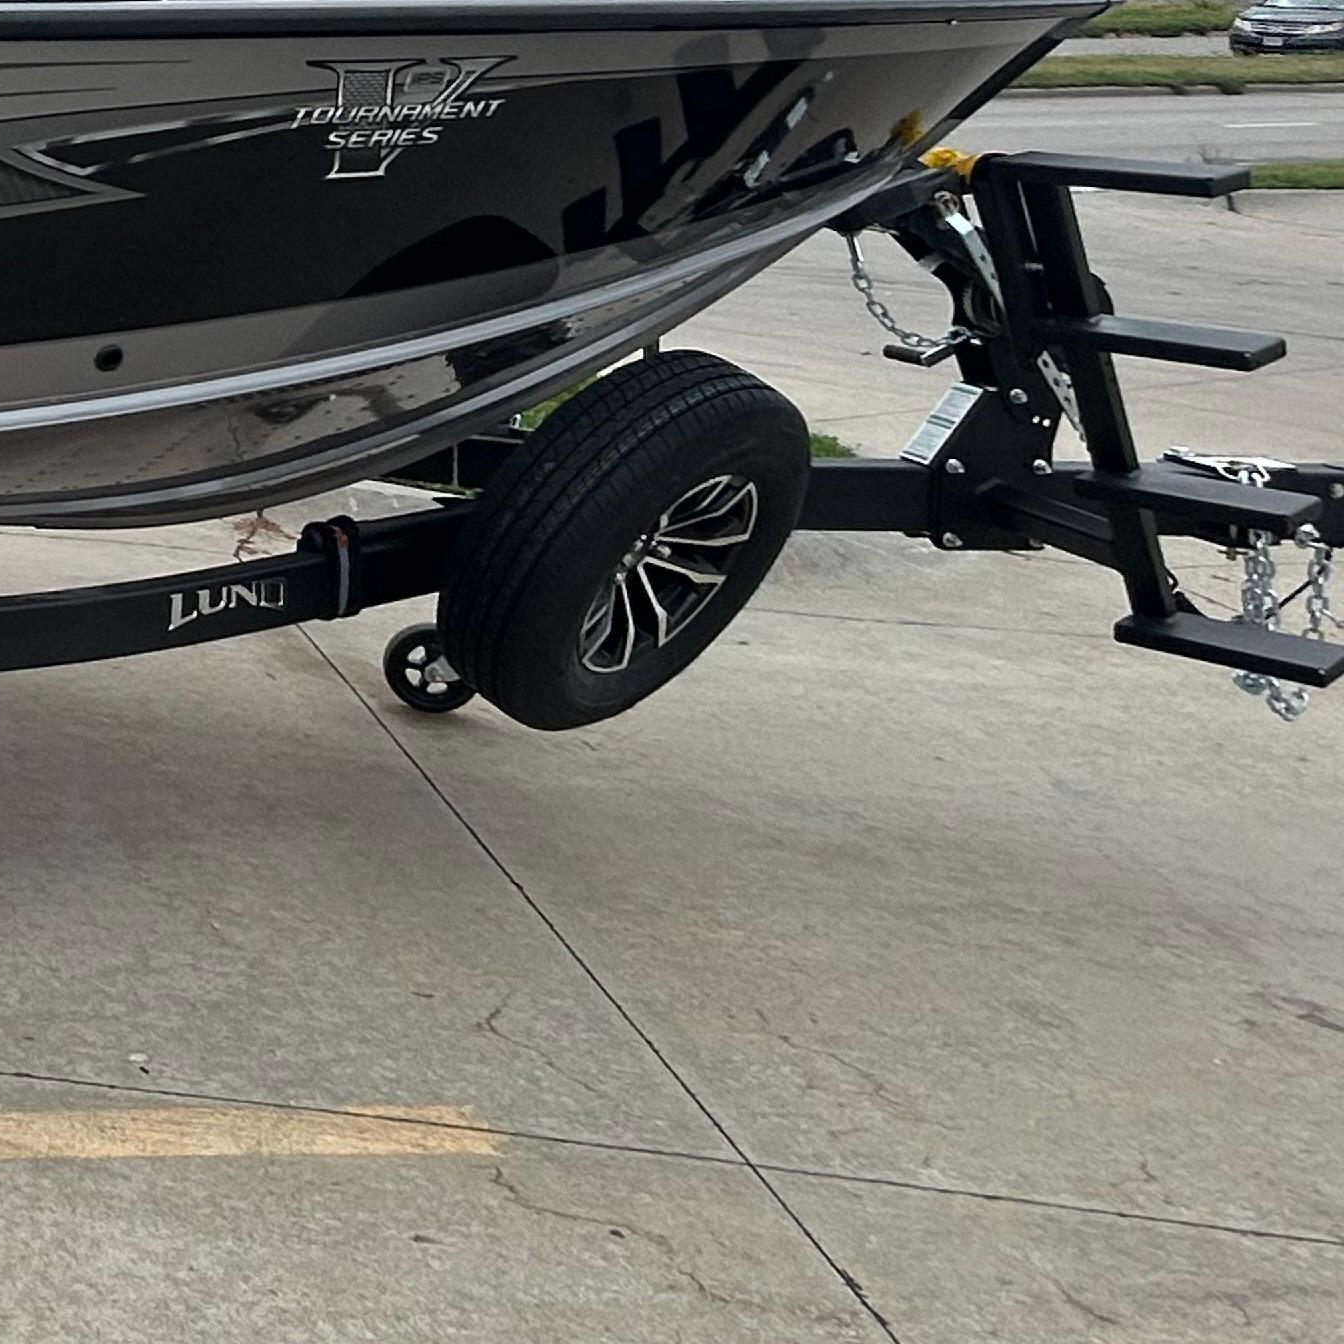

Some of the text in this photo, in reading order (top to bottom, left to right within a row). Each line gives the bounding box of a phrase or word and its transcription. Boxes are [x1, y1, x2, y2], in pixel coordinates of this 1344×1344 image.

[289, 98, 506, 129] TOURNAMENT
[324, 126, 444, 150] SERIES
[167, 580, 285, 632] LUND
